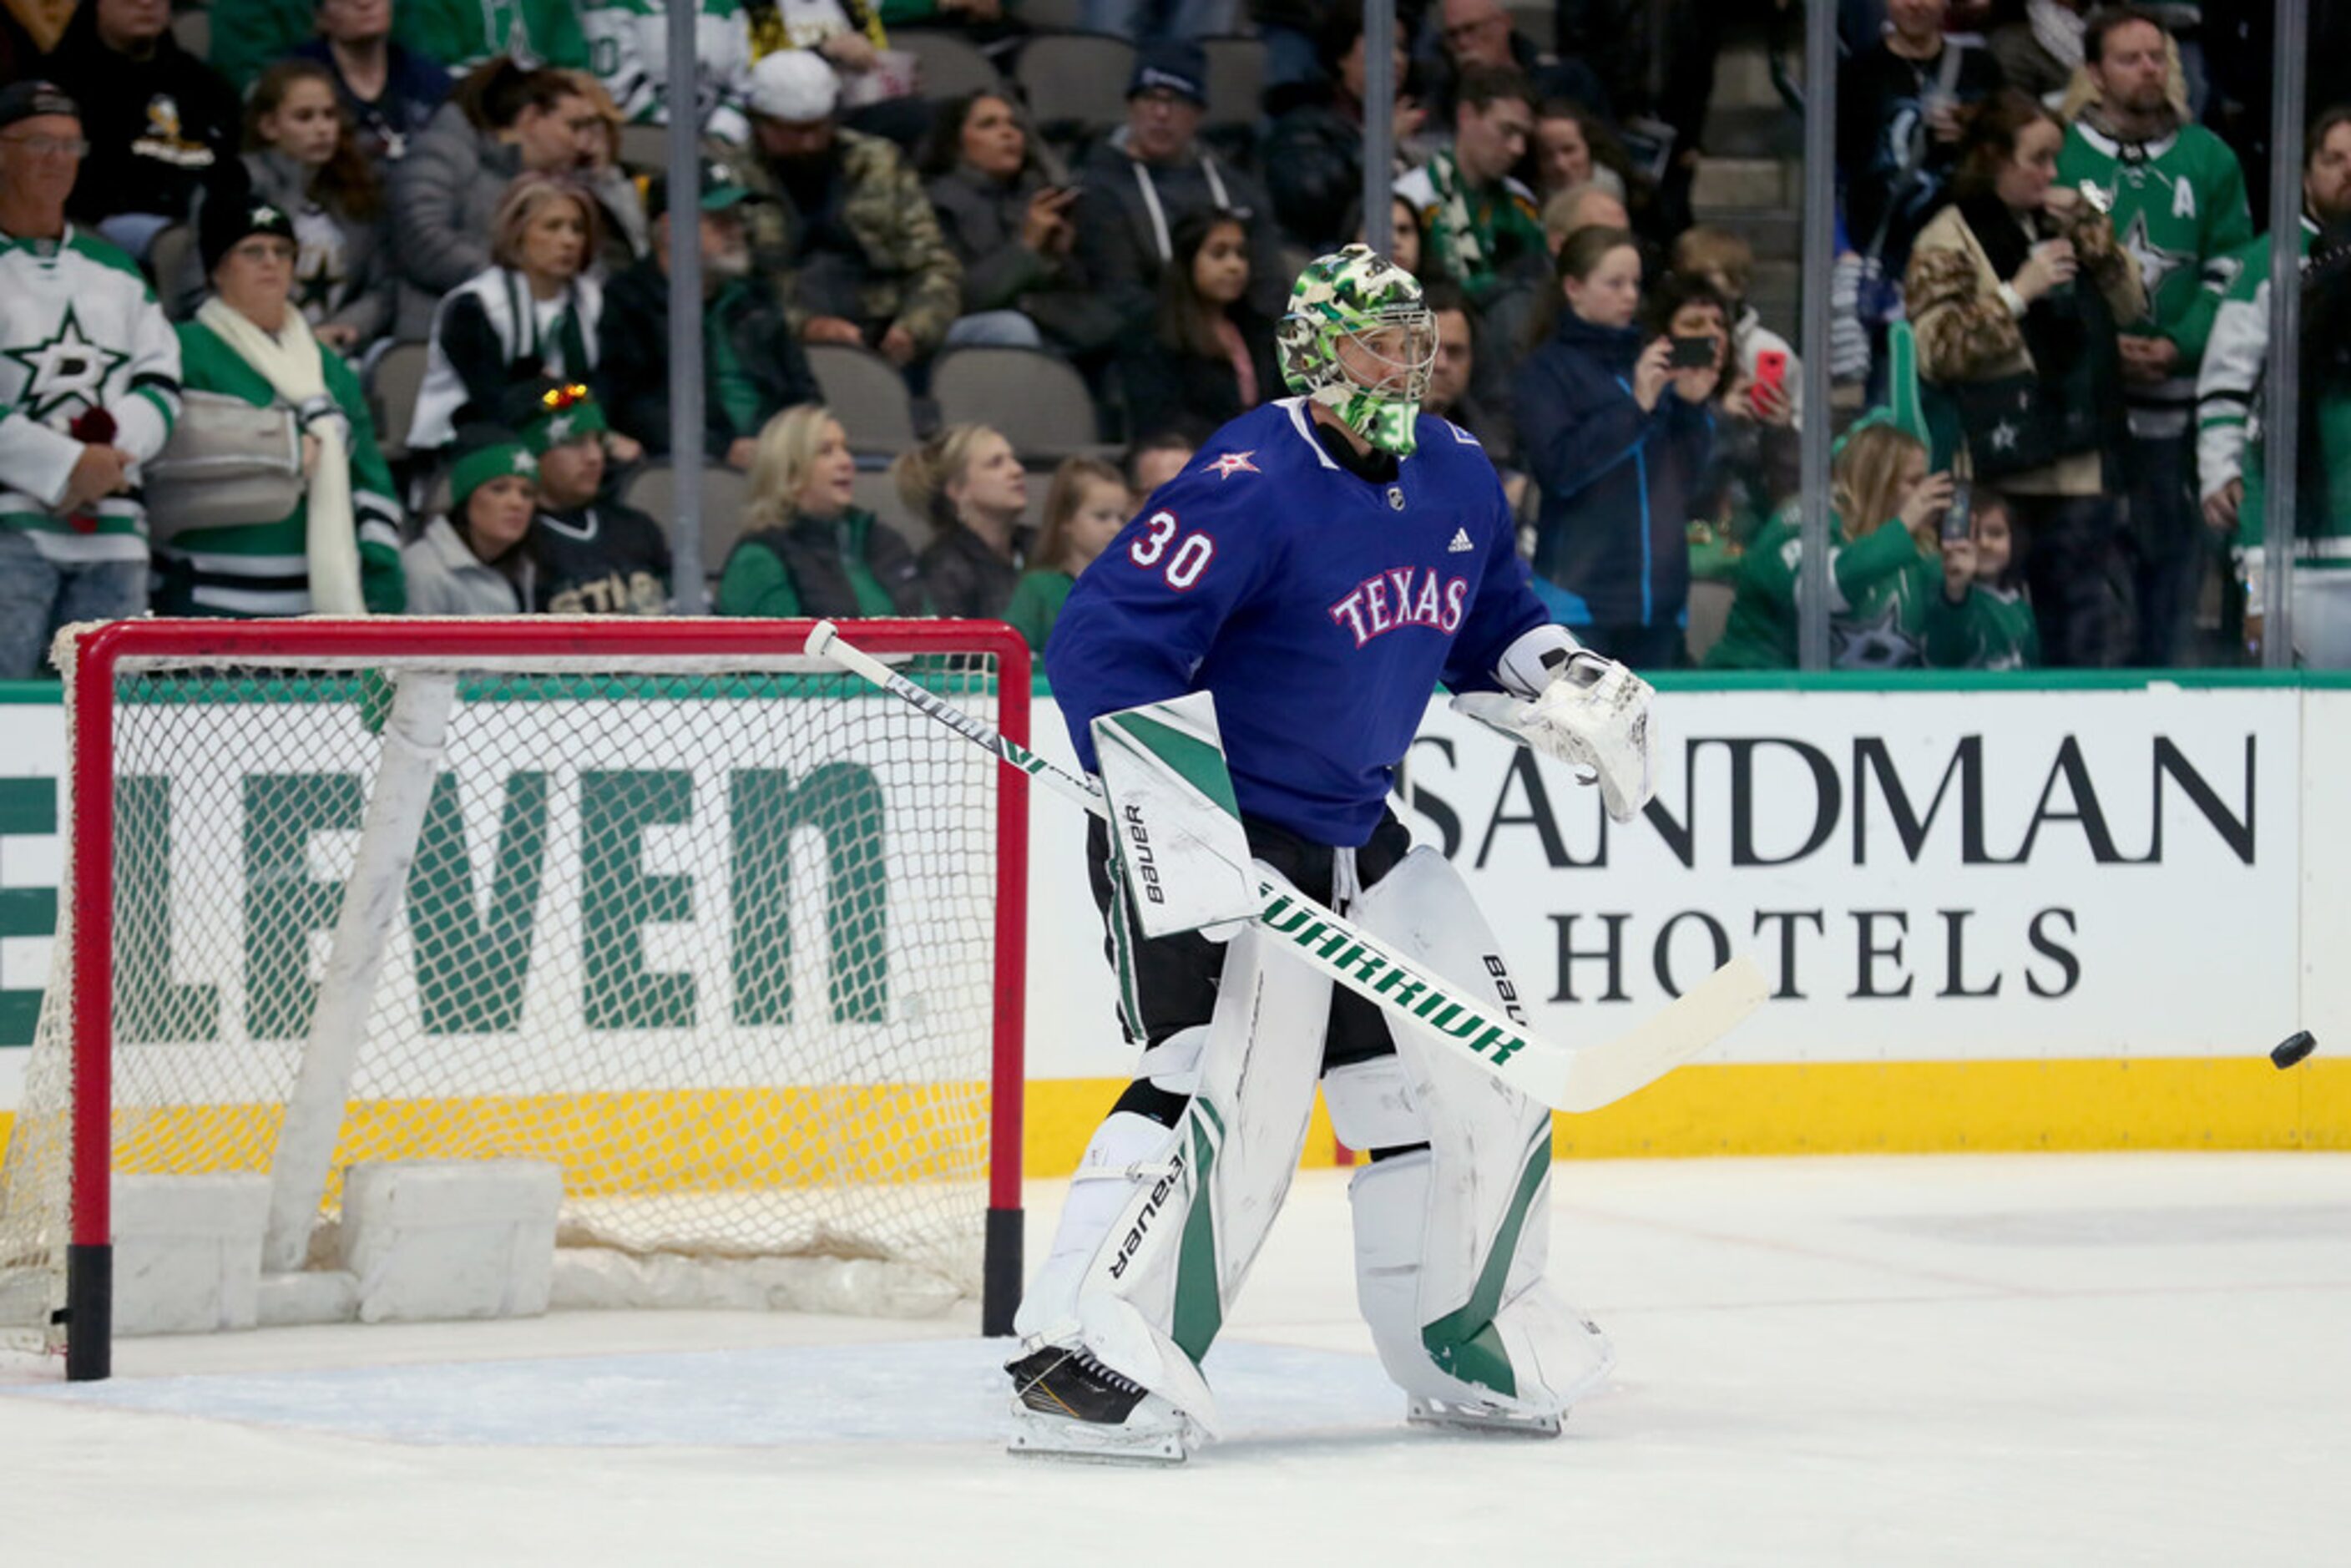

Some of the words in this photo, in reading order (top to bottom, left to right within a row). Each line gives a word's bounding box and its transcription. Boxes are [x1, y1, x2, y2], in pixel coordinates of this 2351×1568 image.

[2172, 175, 2196, 220] A
[1130, 508, 1216, 593] 30
[1329, 566, 1468, 649] TEXAS
[1396, 732, 2257, 869] SANDMAN
[1546, 907, 2081, 1002] HOTELS
